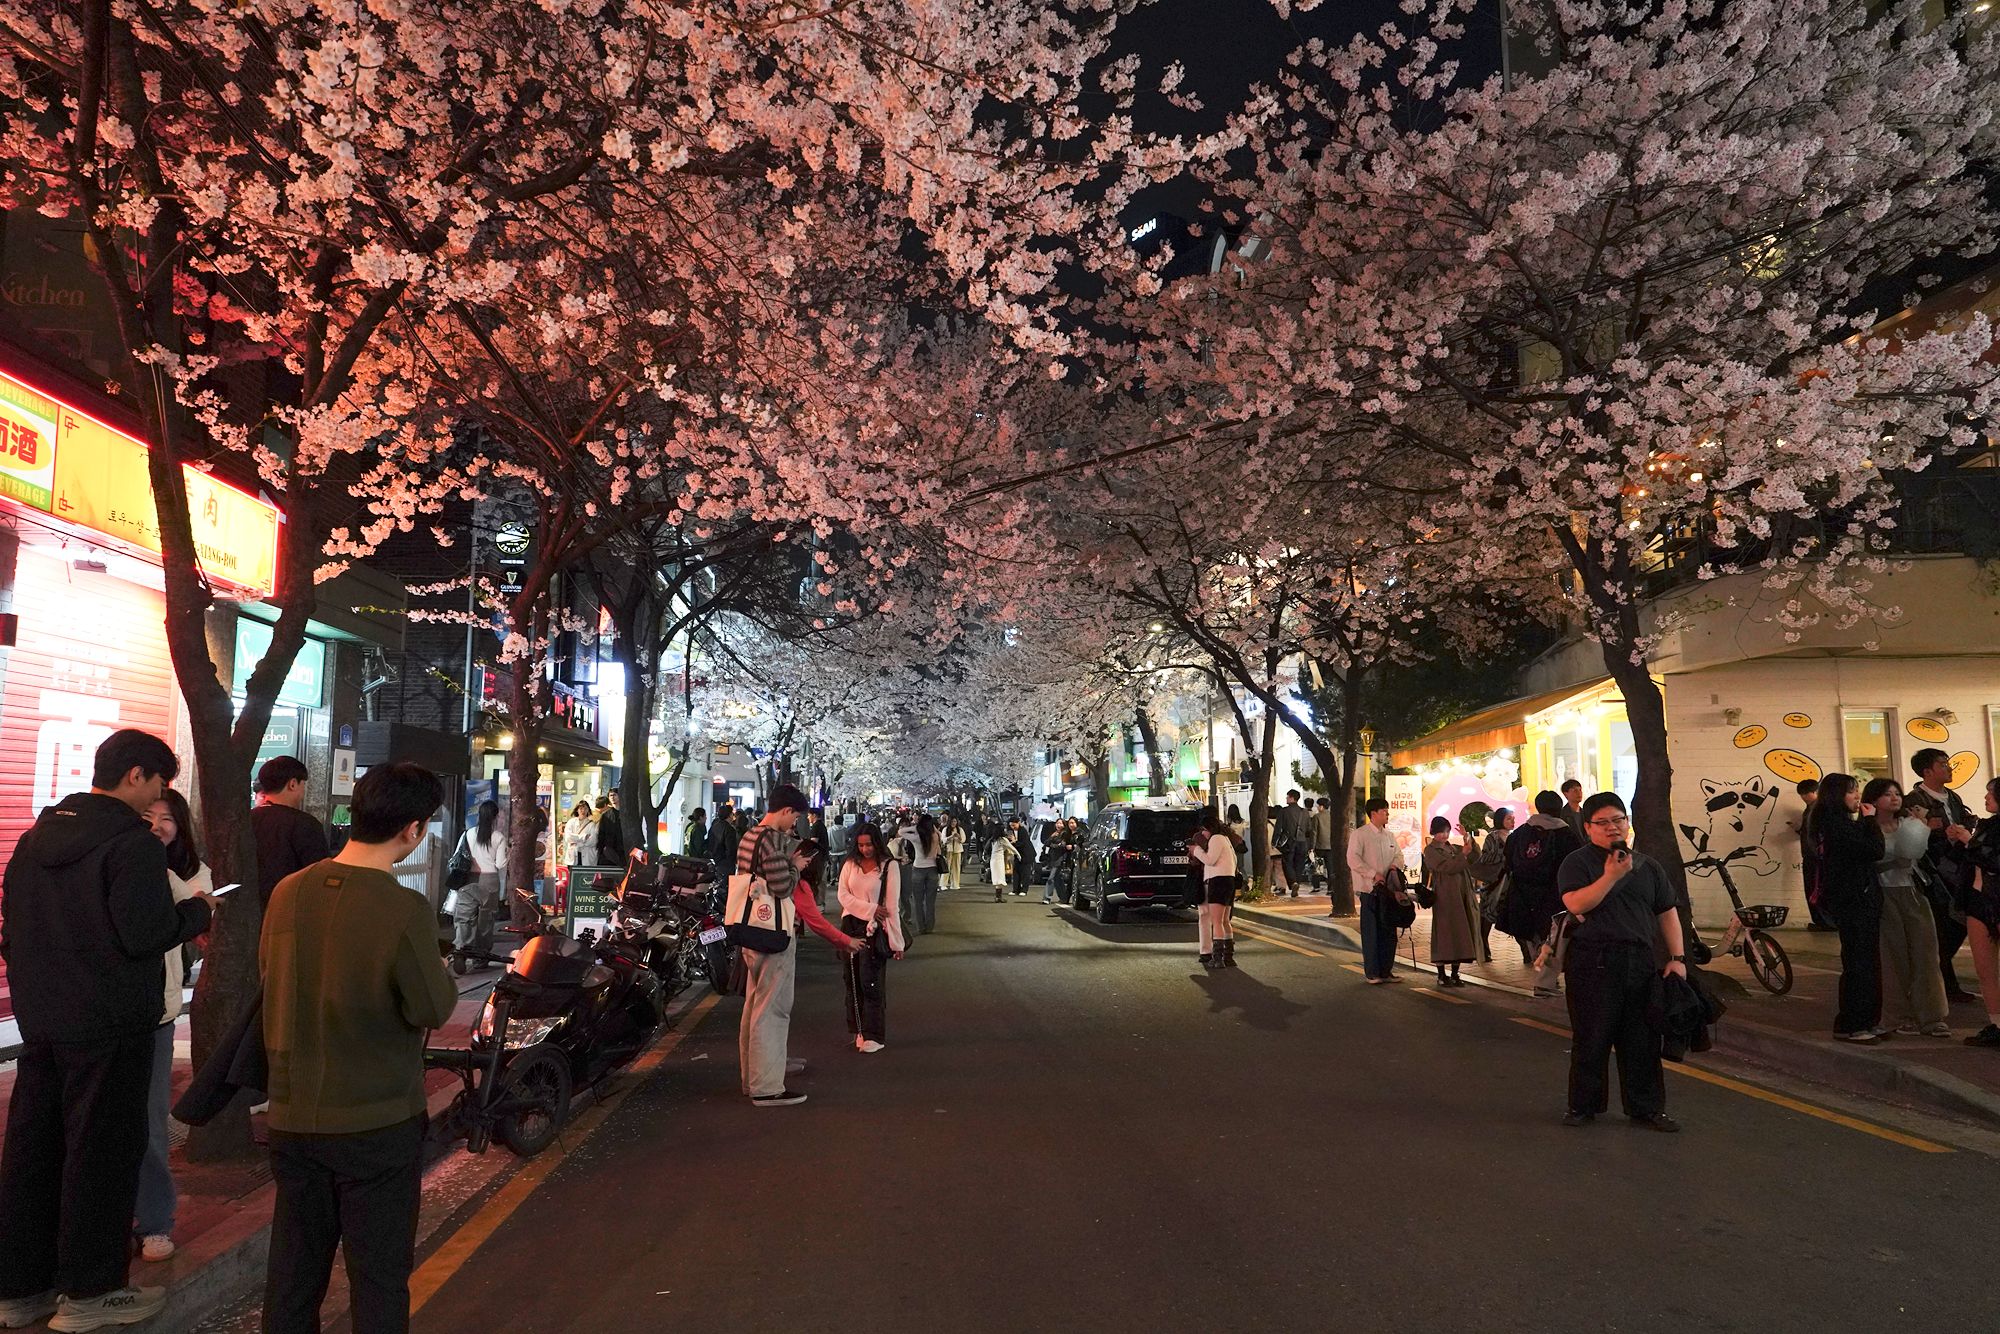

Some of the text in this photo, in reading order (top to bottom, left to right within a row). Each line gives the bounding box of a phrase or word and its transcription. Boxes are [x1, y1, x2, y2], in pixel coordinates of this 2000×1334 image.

[575, 895, 596, 903] WINE
[574, 905, 595, 913] BEER
[102, 1295, 135, 1308] HOKA
